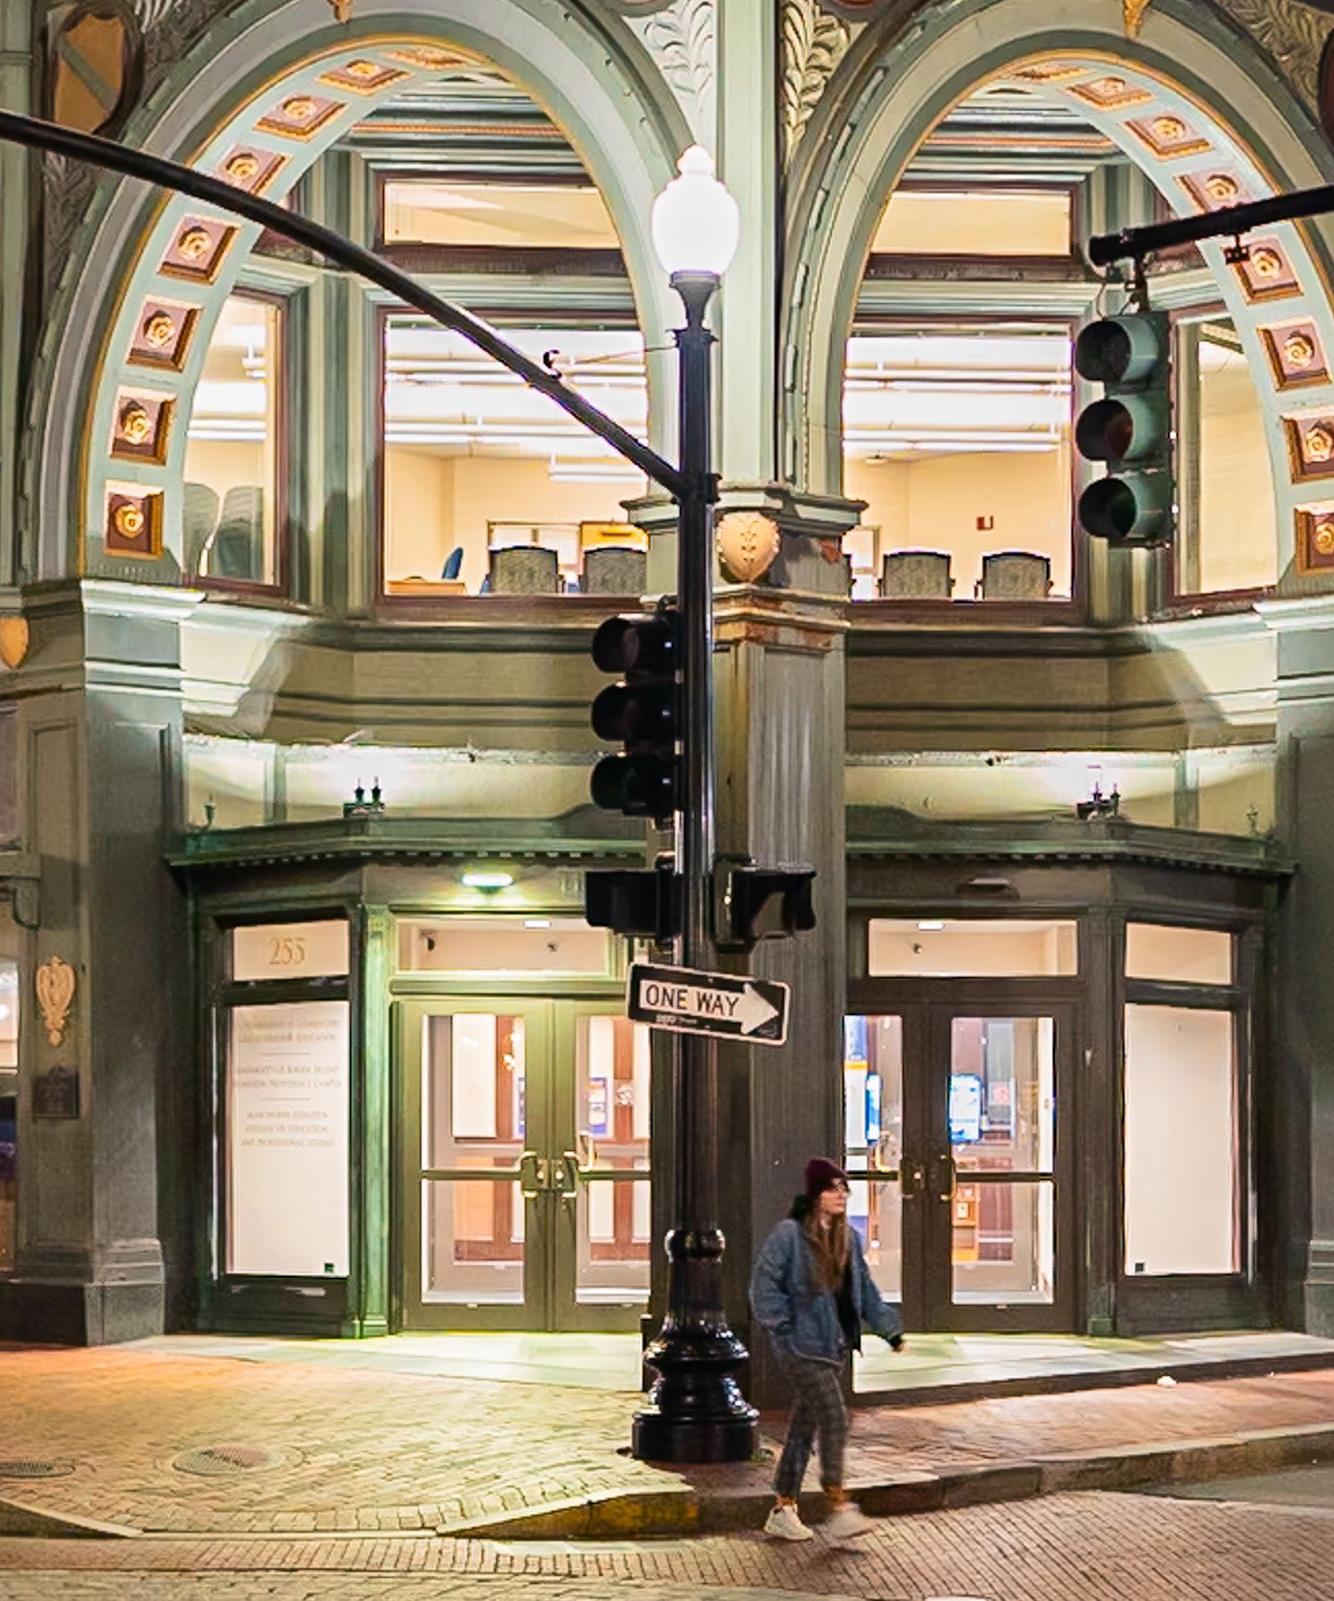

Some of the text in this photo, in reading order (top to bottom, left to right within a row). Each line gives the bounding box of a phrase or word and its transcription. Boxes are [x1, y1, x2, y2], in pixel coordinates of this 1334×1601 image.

[269, 936, 306, 965] 255
[645, 984, 740, 1017] ONE WAY
